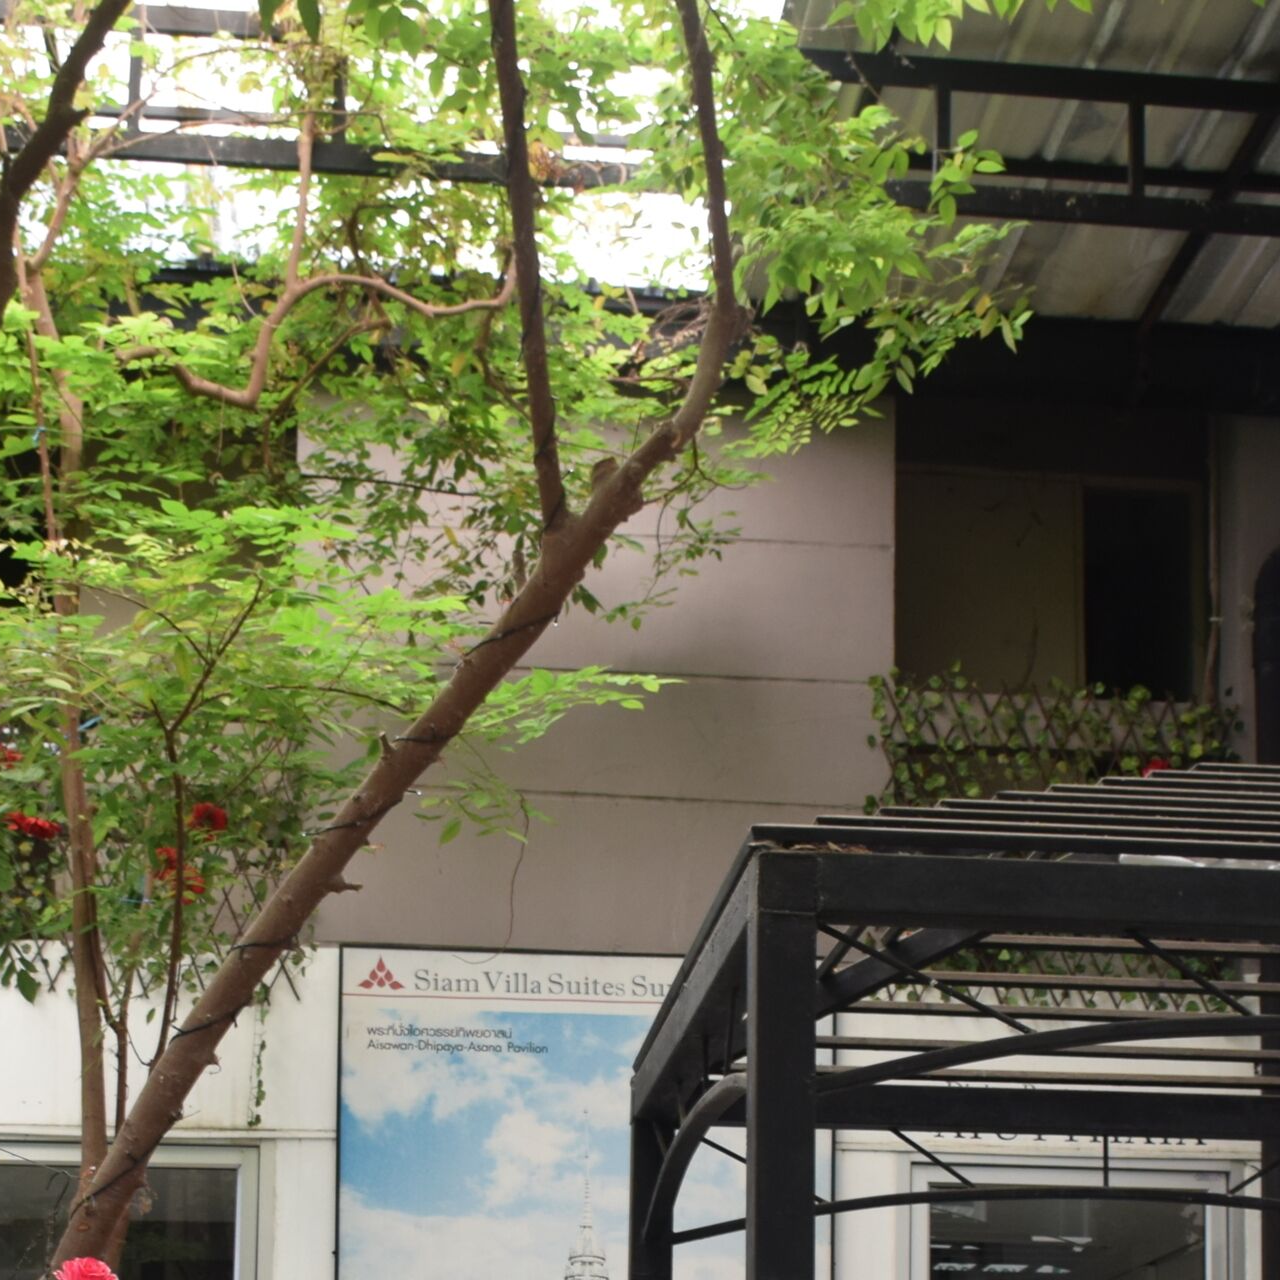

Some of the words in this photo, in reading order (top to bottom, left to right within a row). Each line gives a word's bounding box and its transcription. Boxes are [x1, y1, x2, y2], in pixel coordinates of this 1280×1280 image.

[413, 968, 480, 993] Siam
[482, 970, 542, 994] Villa
[547, 972, 626, 997] Suites
[366, 1039, 503, 1055] Aisawan-Dhipaya-Asana
[506, 1041, 549, 1054] Pavilion
